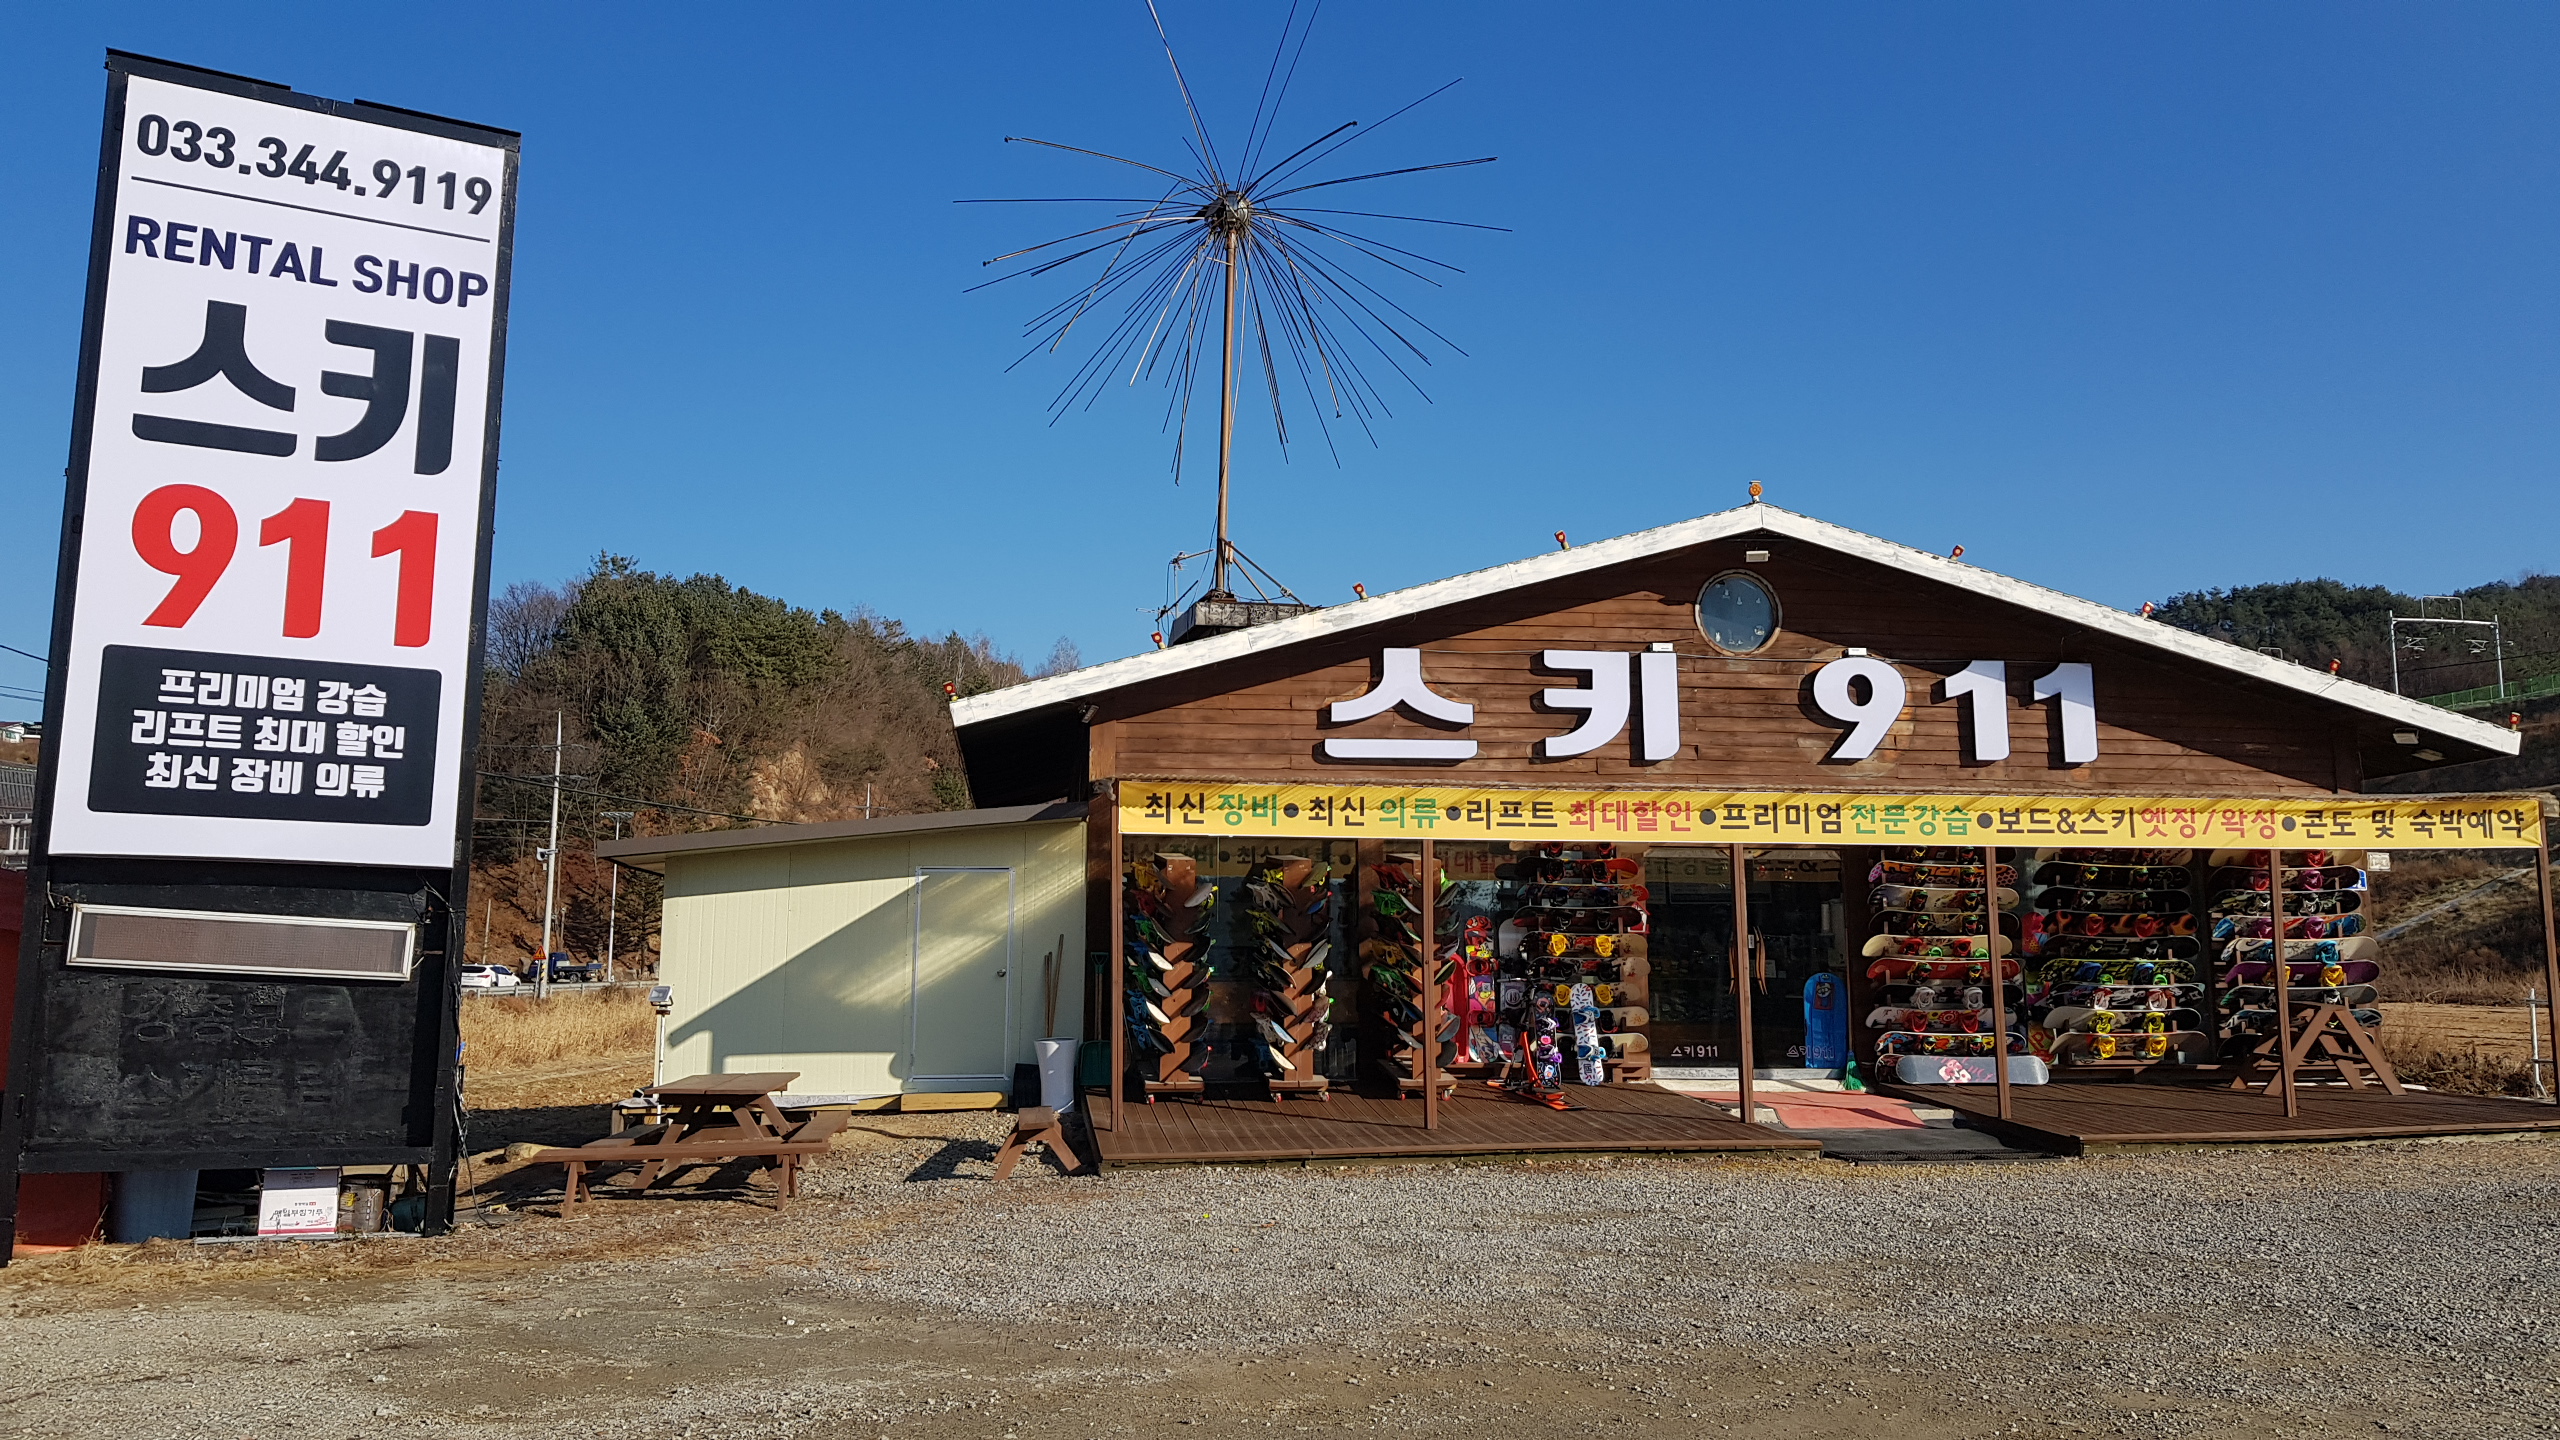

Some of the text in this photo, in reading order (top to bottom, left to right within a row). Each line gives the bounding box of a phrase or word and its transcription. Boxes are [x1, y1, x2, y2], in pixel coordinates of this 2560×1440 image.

[135, 113, 492, 216] 033.344.9119
[124, 214, 489, 309] RENTAL SHOP
[131, 299, 461, 476] 스키
[131, 483, 439, 648] 911
[131, 709, 405, 759] 리프트 최대 할인
[157, 668, 387, 718] 프리미엄 강습
[1324, 647, 2100, 763] 스키 911
[145, 751, 385, 799] 최신 장비 의류
[1144, 792, 1206, 825] 최신
[1218, 793, 1278, 827] 장비
[1308, 795, 1366, 827] 최신
[1379, 796, 1441, 829] 의류
[1465, 798, 1559, 831] 리프트
[1569, 799, 1692, 832] 최대할인
[2300, 809, 2357, 840] 콘도
[2371, 809, 2395, 840] 및
[2408, 808, 2526, 840] 숙박예약
